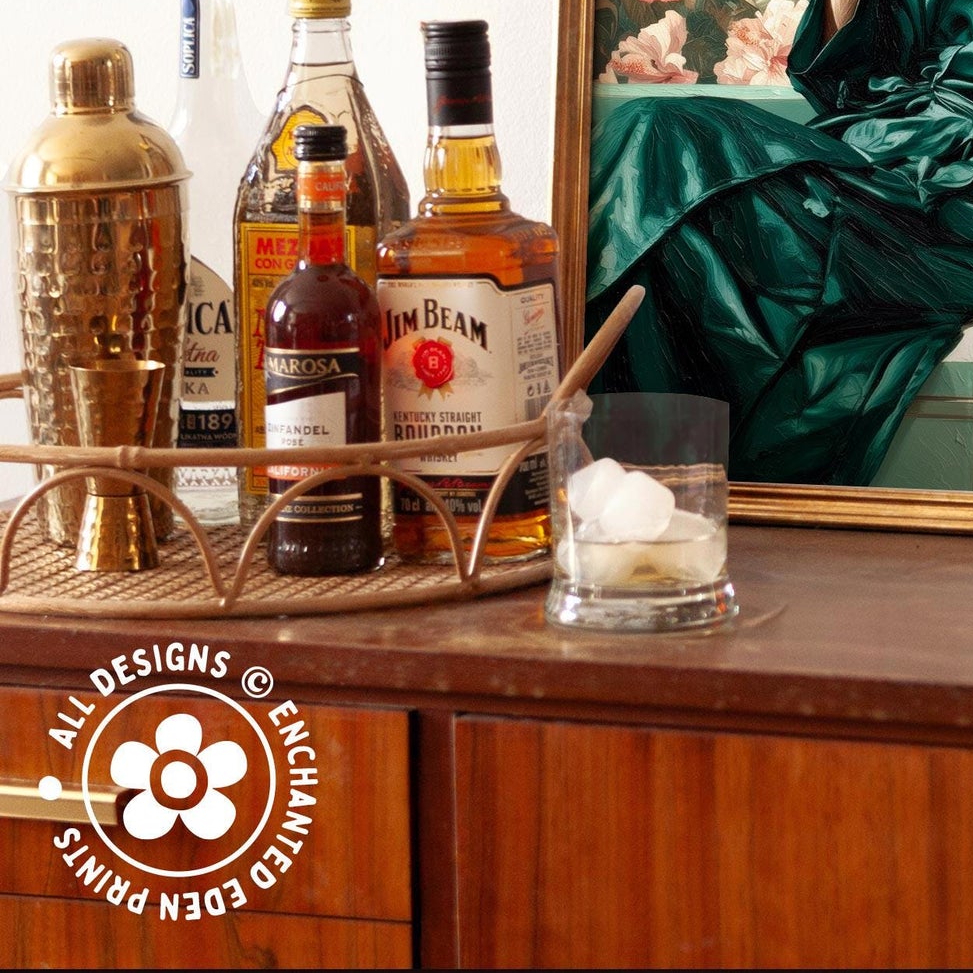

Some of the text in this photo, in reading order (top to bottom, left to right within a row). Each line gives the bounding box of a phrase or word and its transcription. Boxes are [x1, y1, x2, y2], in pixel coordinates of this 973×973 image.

[182, 17, 195, 75] SOPLICA
[255, 258, 281, 269] CON
[384, 308, 418, 352] JIM
[423, 298, 488, 351] BEAM
[198, 412, 233, 431] 189
[393, 412, 482, 423] KENTUCKY STRAIGHT
[267, 423, 330, 436] ZINFANDEL
[294, 504, 354, 514] COLLECTION
[467, 500, 482, 512] vol
